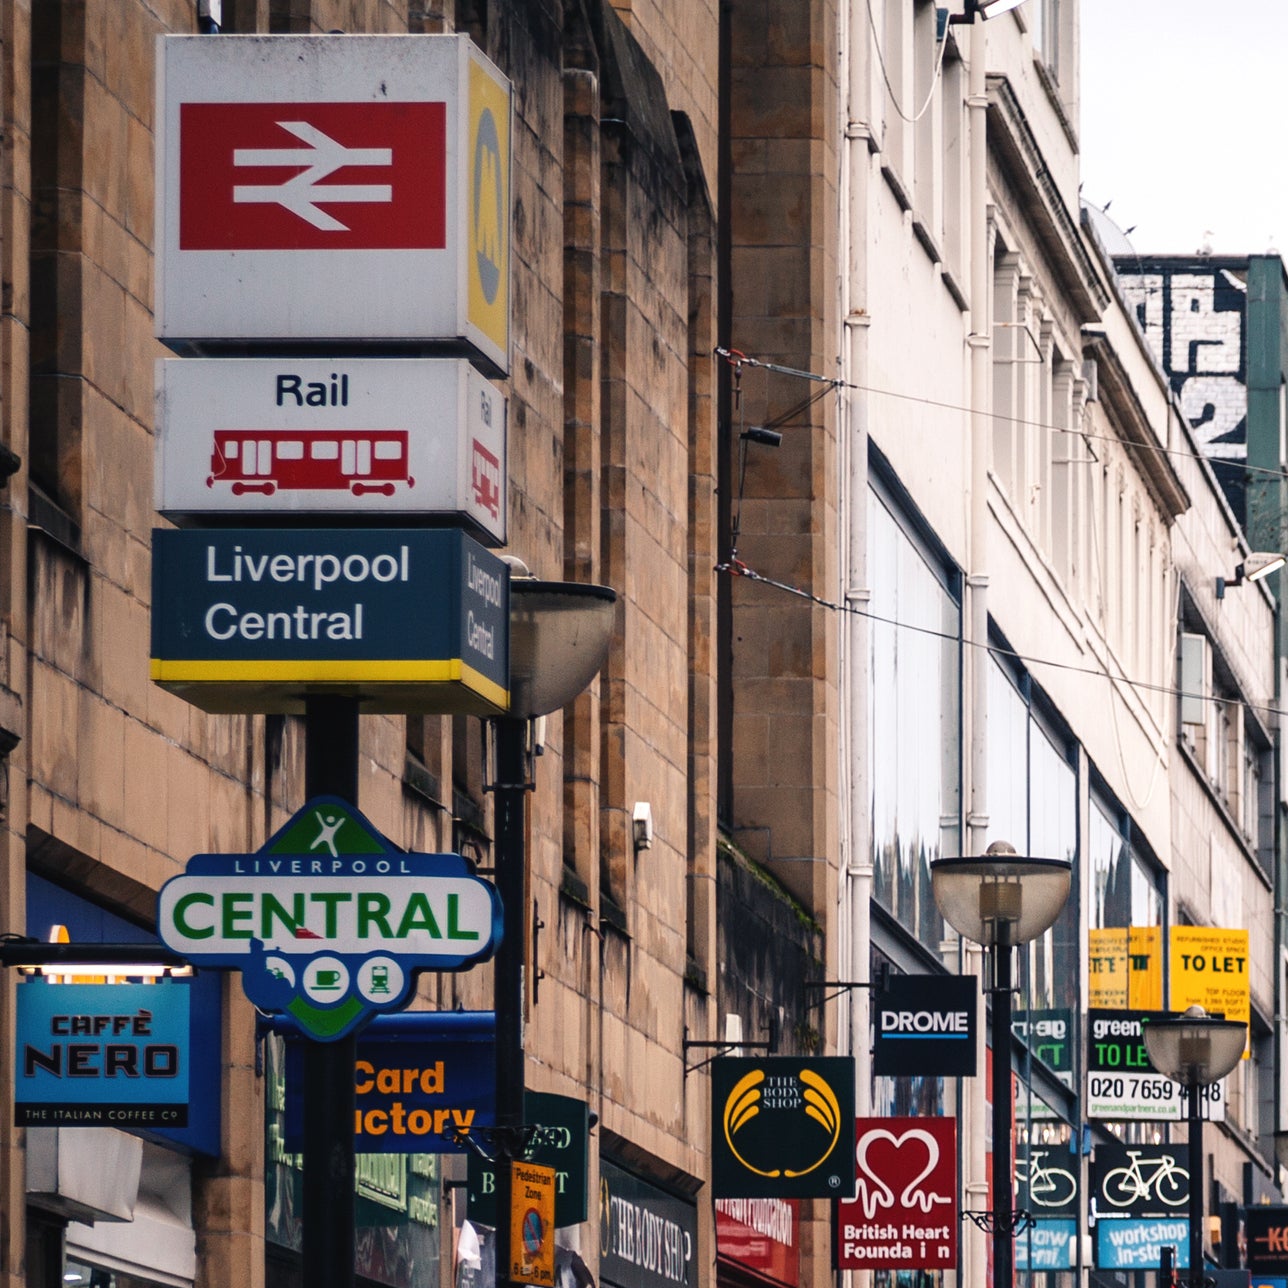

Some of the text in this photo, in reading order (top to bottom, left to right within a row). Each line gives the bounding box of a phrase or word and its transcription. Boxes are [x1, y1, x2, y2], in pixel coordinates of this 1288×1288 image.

[275, 374, 349, 407] Rail
[205, 544, 410, 590] Liverpool
[204, 603, 364, 641] Central
[235, 860, 411, 874] LIVERPOOL
[171, 891, 479, 940] CENTRAL
[1181, 954, 1246, 973] TO LET
[51, 1009, 153, 1037] CAFFÈ
[881, 1010, 969, 1032] DROME
[23, 1043, 180, 1079] NERO
[1095, 1044, 1149, 1066] TO LE
[354, 1060, 445, 1095] Card
[766, 1076, 798, 1087] THE
[1091, 1077, 1124, 1098] 020
[1129, 1078, 1173, 1100] 7659
[763, 1087, 802, 1098] BODY
[763, 1098, 802, 1109] SHOP
[26, 1109, 50, 1120] THE
[53, 1109, 103, 1120] ITALIAN
[108, 1109, 158, 1120] COFFEE
[515, 1167, 552, 1186] Pedestrian
[525, 1186, 542, 1201] Zone
[635, 1206, 664, 1275] BODY
[844, 1224, 950, 1240] British Heart
[1109, 1222, 1188, 1247] workshop
